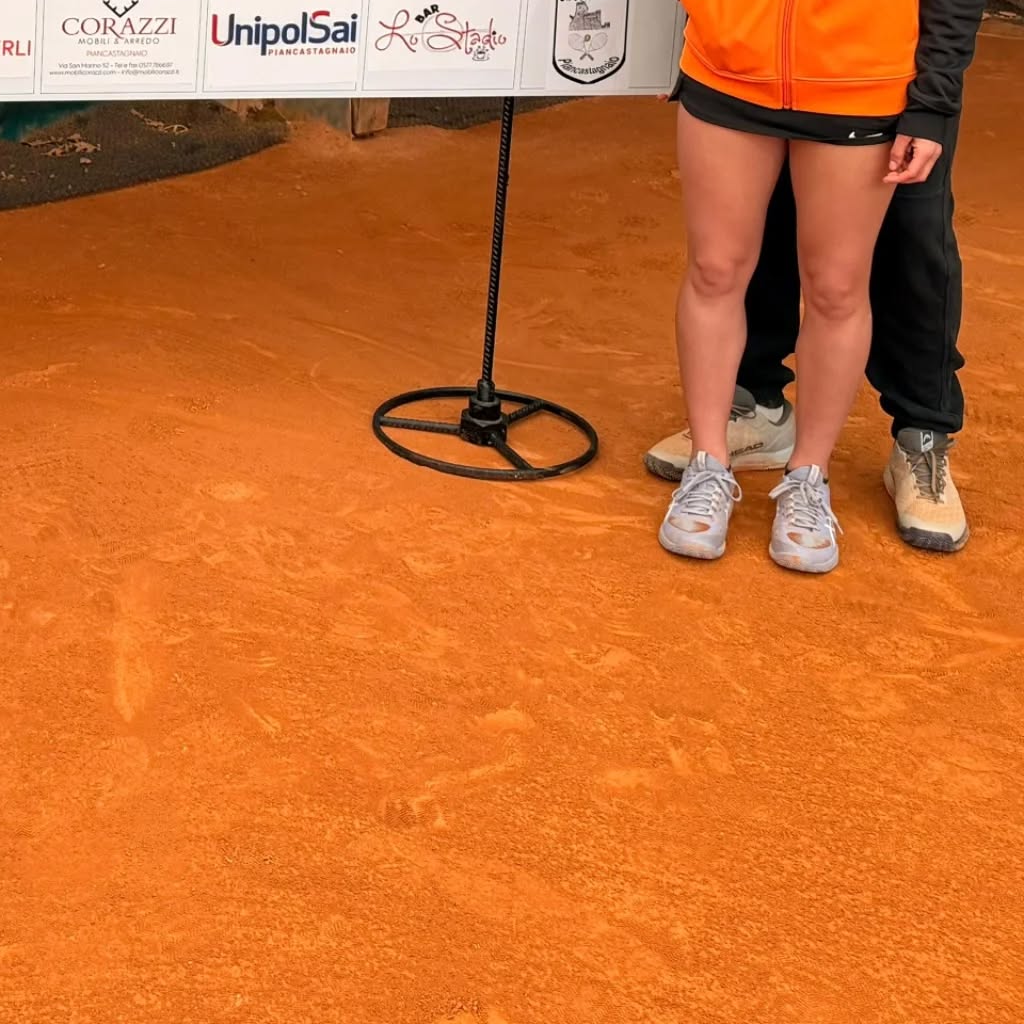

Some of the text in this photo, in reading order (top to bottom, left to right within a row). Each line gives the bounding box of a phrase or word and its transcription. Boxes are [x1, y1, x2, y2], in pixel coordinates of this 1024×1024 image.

[415, 4, 439, 23] BAR
[62, 17, 177, 39] CORAZZI
[211, 10, 358, 56] UnipolSai
[268, 47, 356, 56] PIANCASTAGNAIO
[557, 56, 619, 74] Piancastagnaio
